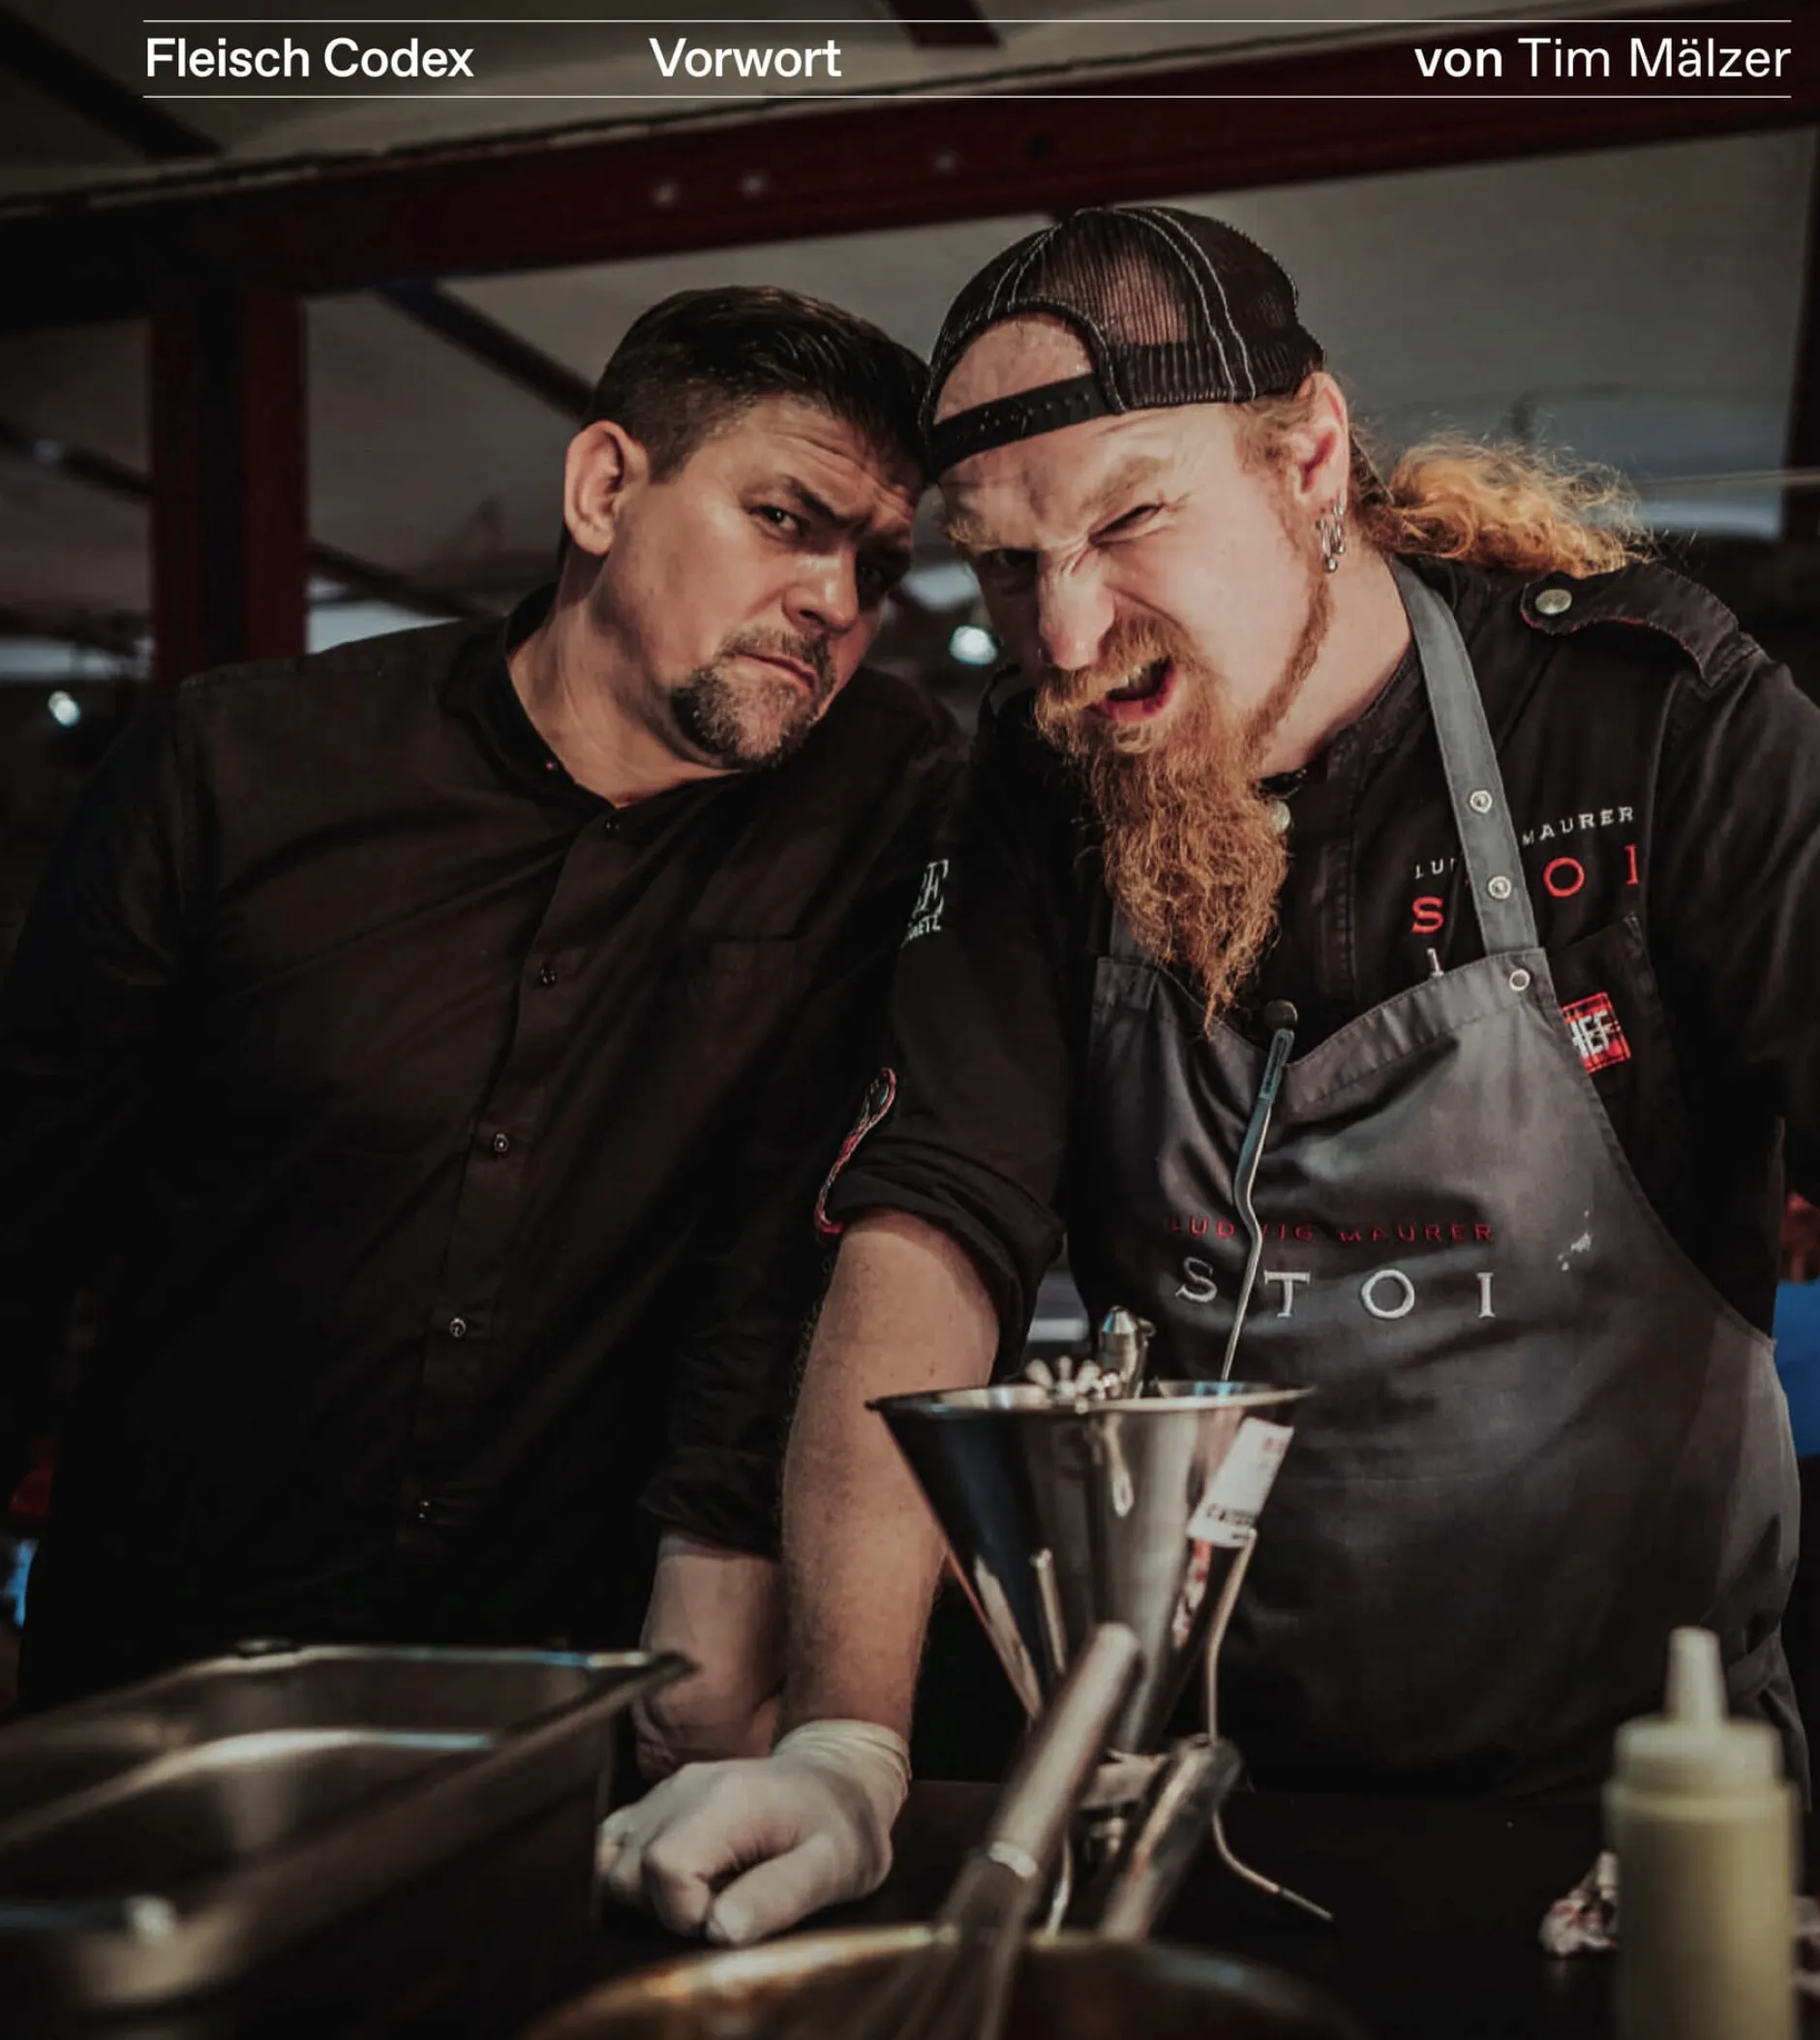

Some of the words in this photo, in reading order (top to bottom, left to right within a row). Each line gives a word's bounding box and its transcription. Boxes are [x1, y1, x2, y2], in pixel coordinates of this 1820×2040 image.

[1522, 806, 1634, 846] MAURER
[1410, 843, 1639, 934] SOI
[1571, 1012, 1615, 1059] HEF
[1170, 1216, 1317, 1241] LUDIG
[1338, 1223, 1496, 1243] MAURER
[1174, 1257, 1497, 1321] STOI
